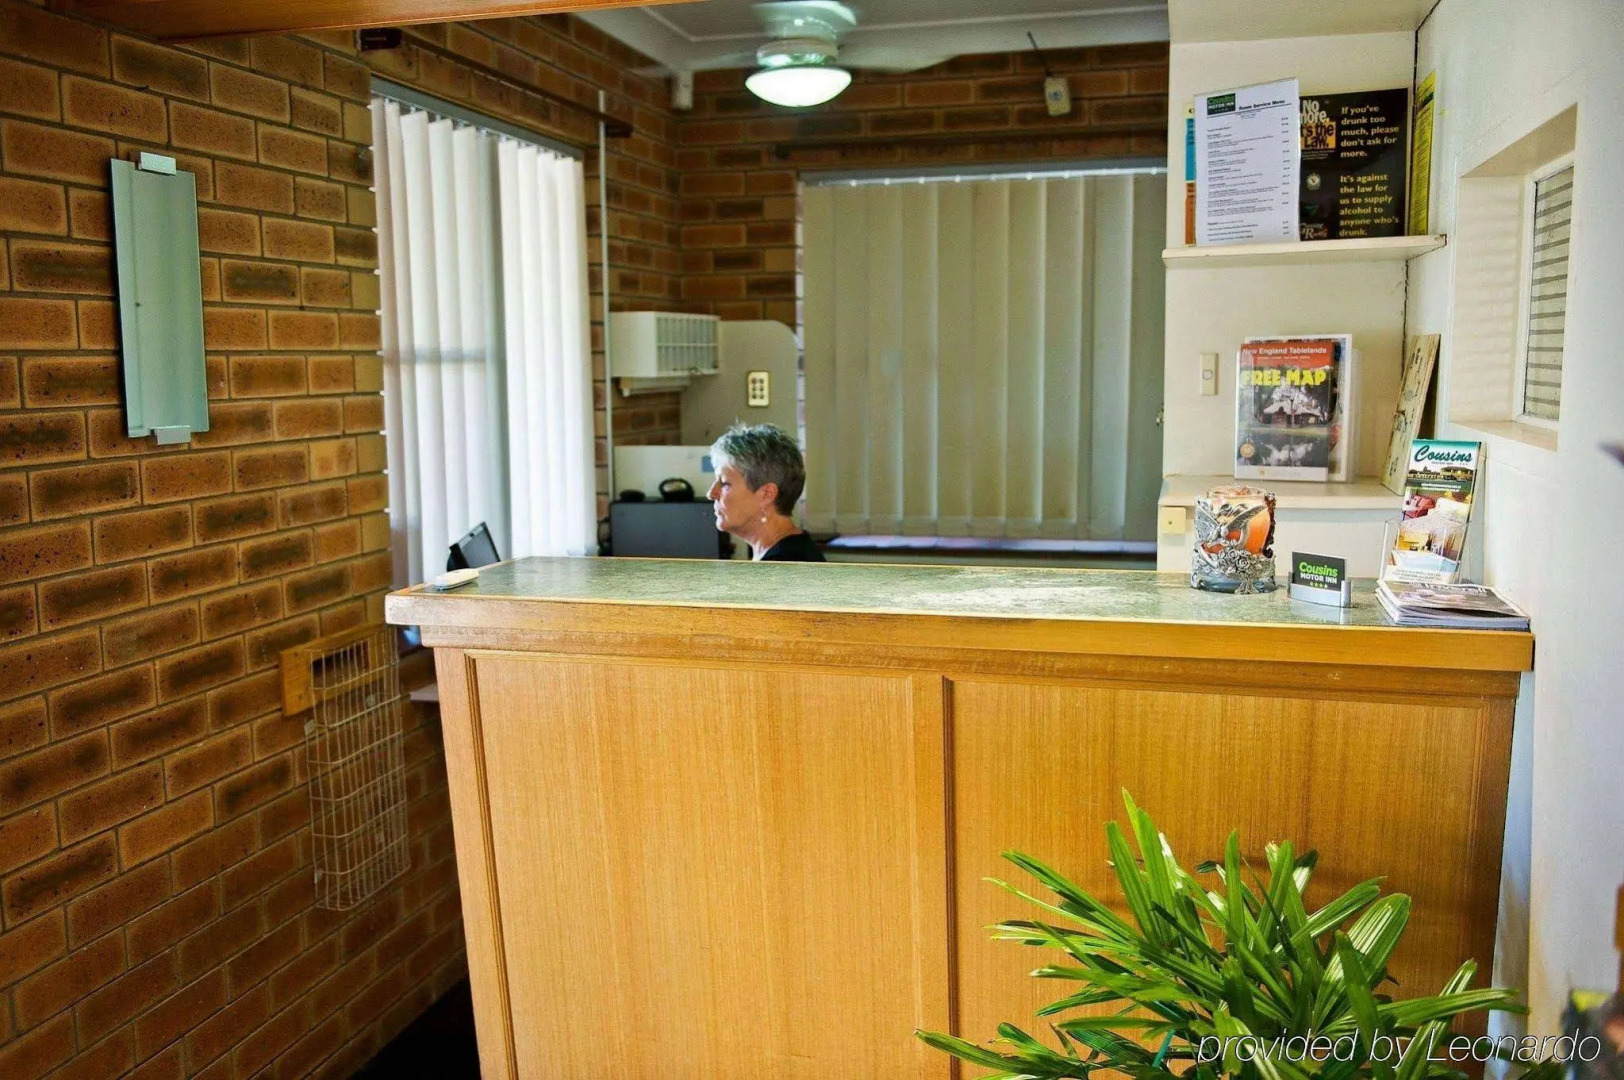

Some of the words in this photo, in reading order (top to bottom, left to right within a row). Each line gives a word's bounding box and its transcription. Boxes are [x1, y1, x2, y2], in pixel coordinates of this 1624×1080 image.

[1302, 100, 1320, 112] No
[1341, 106, 1349, 114] If
[1350, 105, 1379, 116] you've
[1341, 117, 1368, 125] drunk
[1315, 121, 1334, 136] the
[1341, 127, 1368, 136] much,
[1371, 126, 1399, 136] please
[1304, 134, 1330, 148] Law.
[1340, 138, 1364, 147] don't
[1366, 137, 1381, 146] ask
[1383, 136, 1397, 144] for
[1340, 150, 1368, 158] more.
[1340, 175, 1354, 183] It's
[1356, 174, 1388, 184] against
[1340, 186, 1355, 194] the
[1357, 185, 1373, 193] law
[1375, 184, 1388, 192] for
[1364, 195, 1393, 204] supply
[1339, 206, 1371, 215] alcohol
[1339, 218, 1371, 227] anyone
[1373, 216, 1399, 224] who's
[1339, 229, 1368, 237] drunk.
[1258, 347, 1287, 355] England
[1289, 346, 1327, 354] Tablelands
[1241, 369, 1281, 386] FREE
[1285, 369, 1327, 386] MAP
[1414, 444, 1473, 462] Cousins
[1299, 561, 1338, 577] Cousins
[1300, 572, 1324, 582] MOTOR
[1325, 576, 1337, 584] INN
